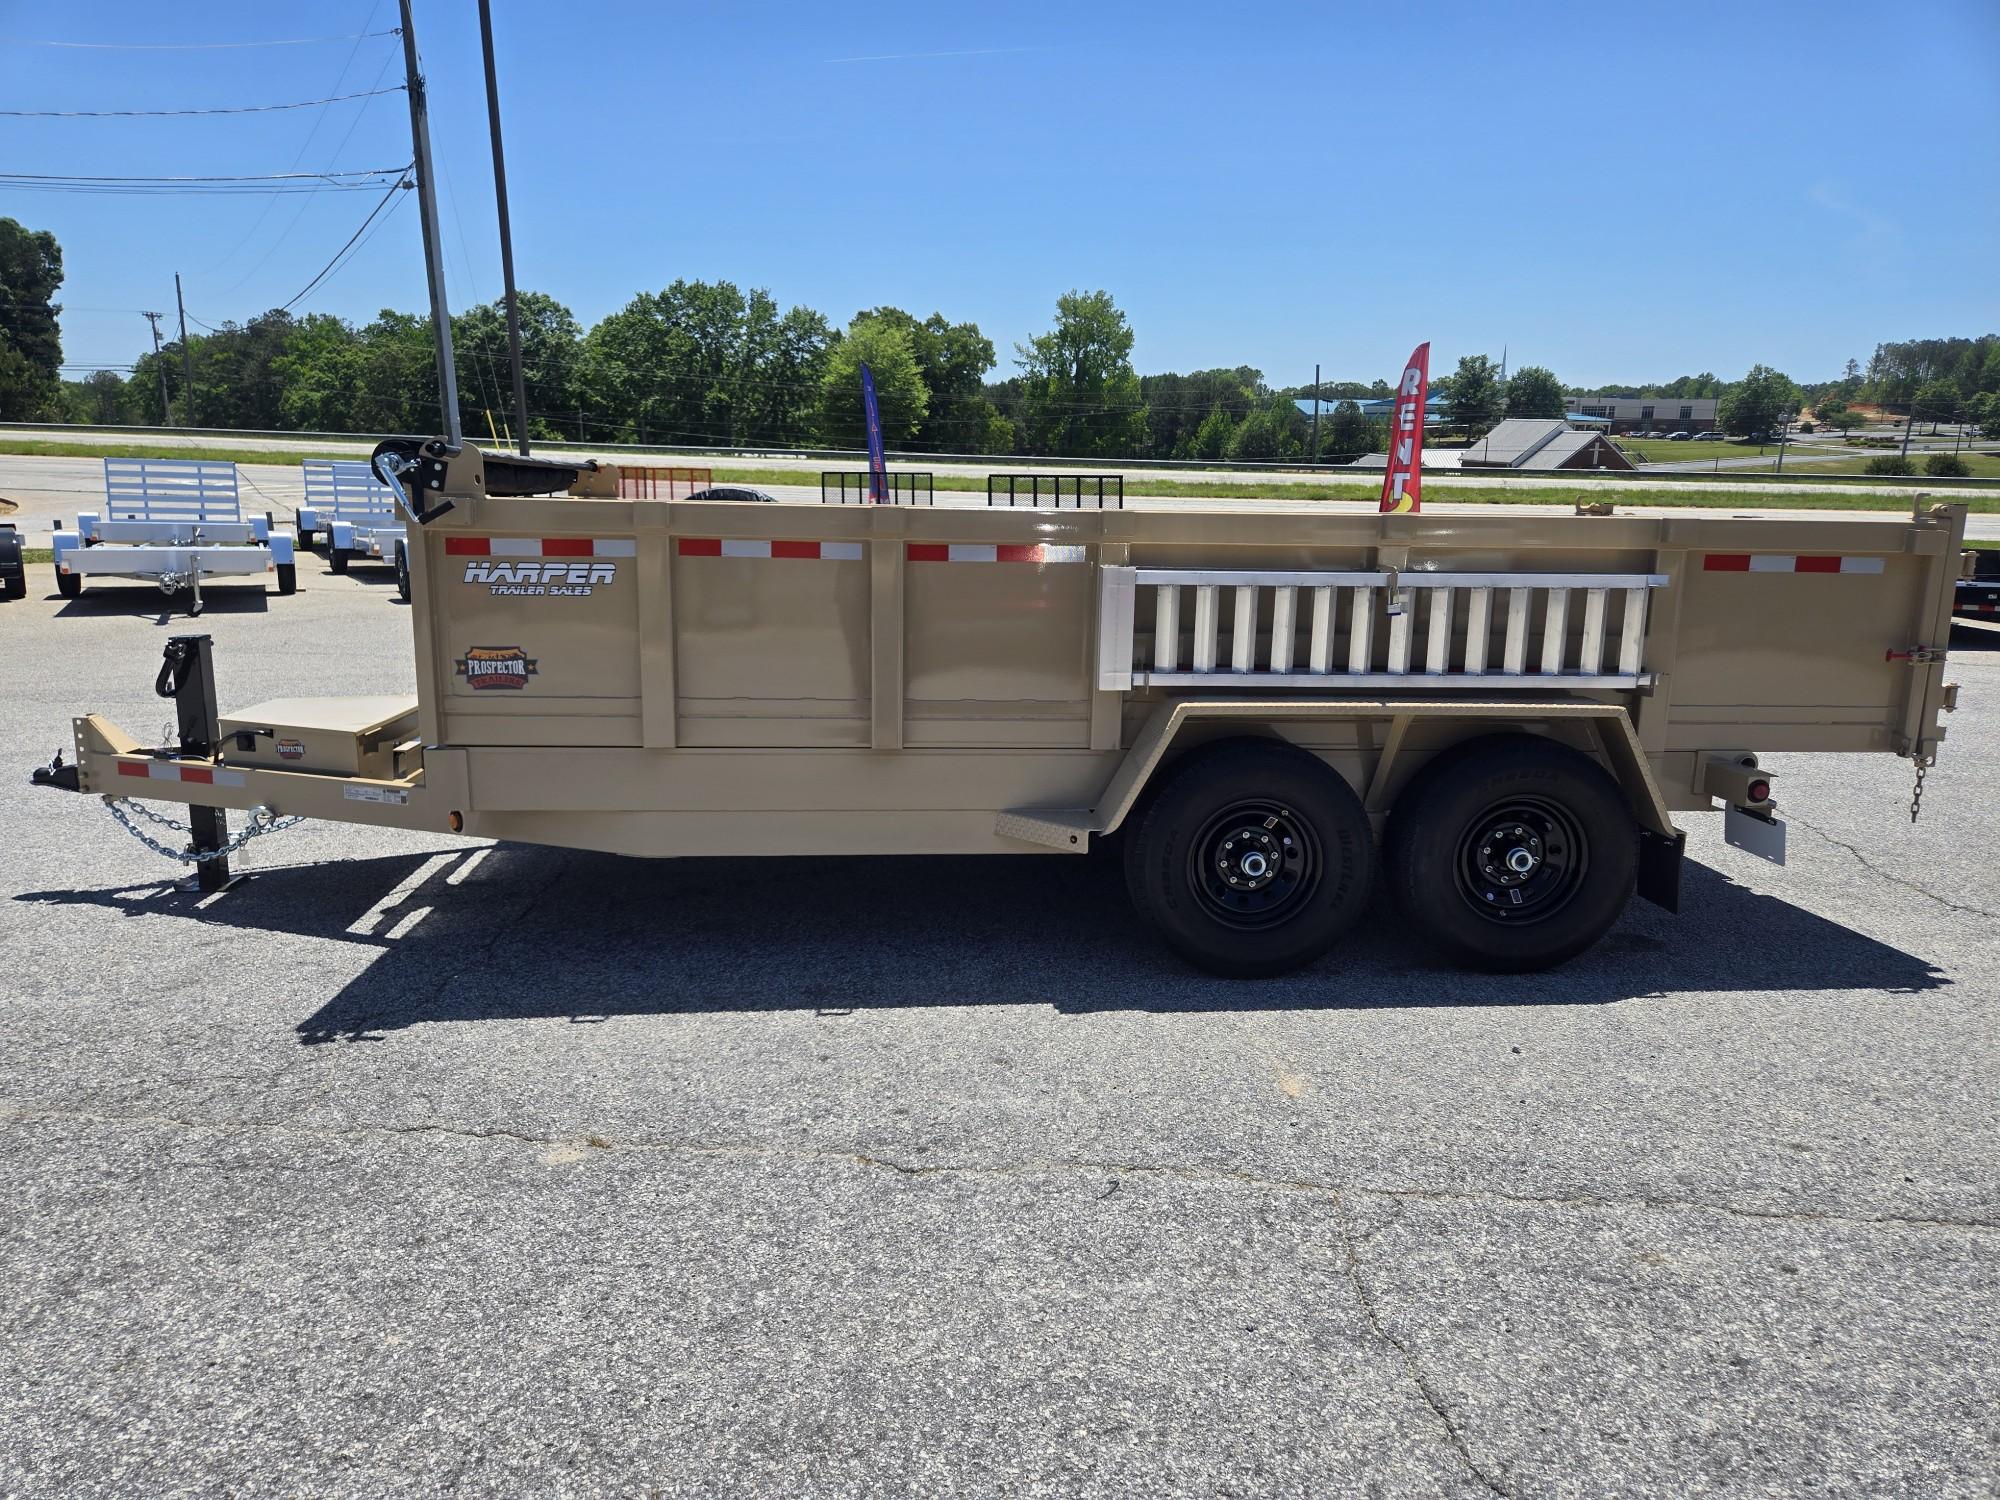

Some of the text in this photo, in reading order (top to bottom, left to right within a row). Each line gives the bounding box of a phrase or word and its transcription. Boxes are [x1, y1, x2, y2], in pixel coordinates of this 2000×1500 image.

[1392, 367, 1422, 501] RENT
[464, 561, 616, 584] HARPER
[489, 585, 593, 597] TRAILER SALES
[468, 660, 526, 675] PROSPECTOR
